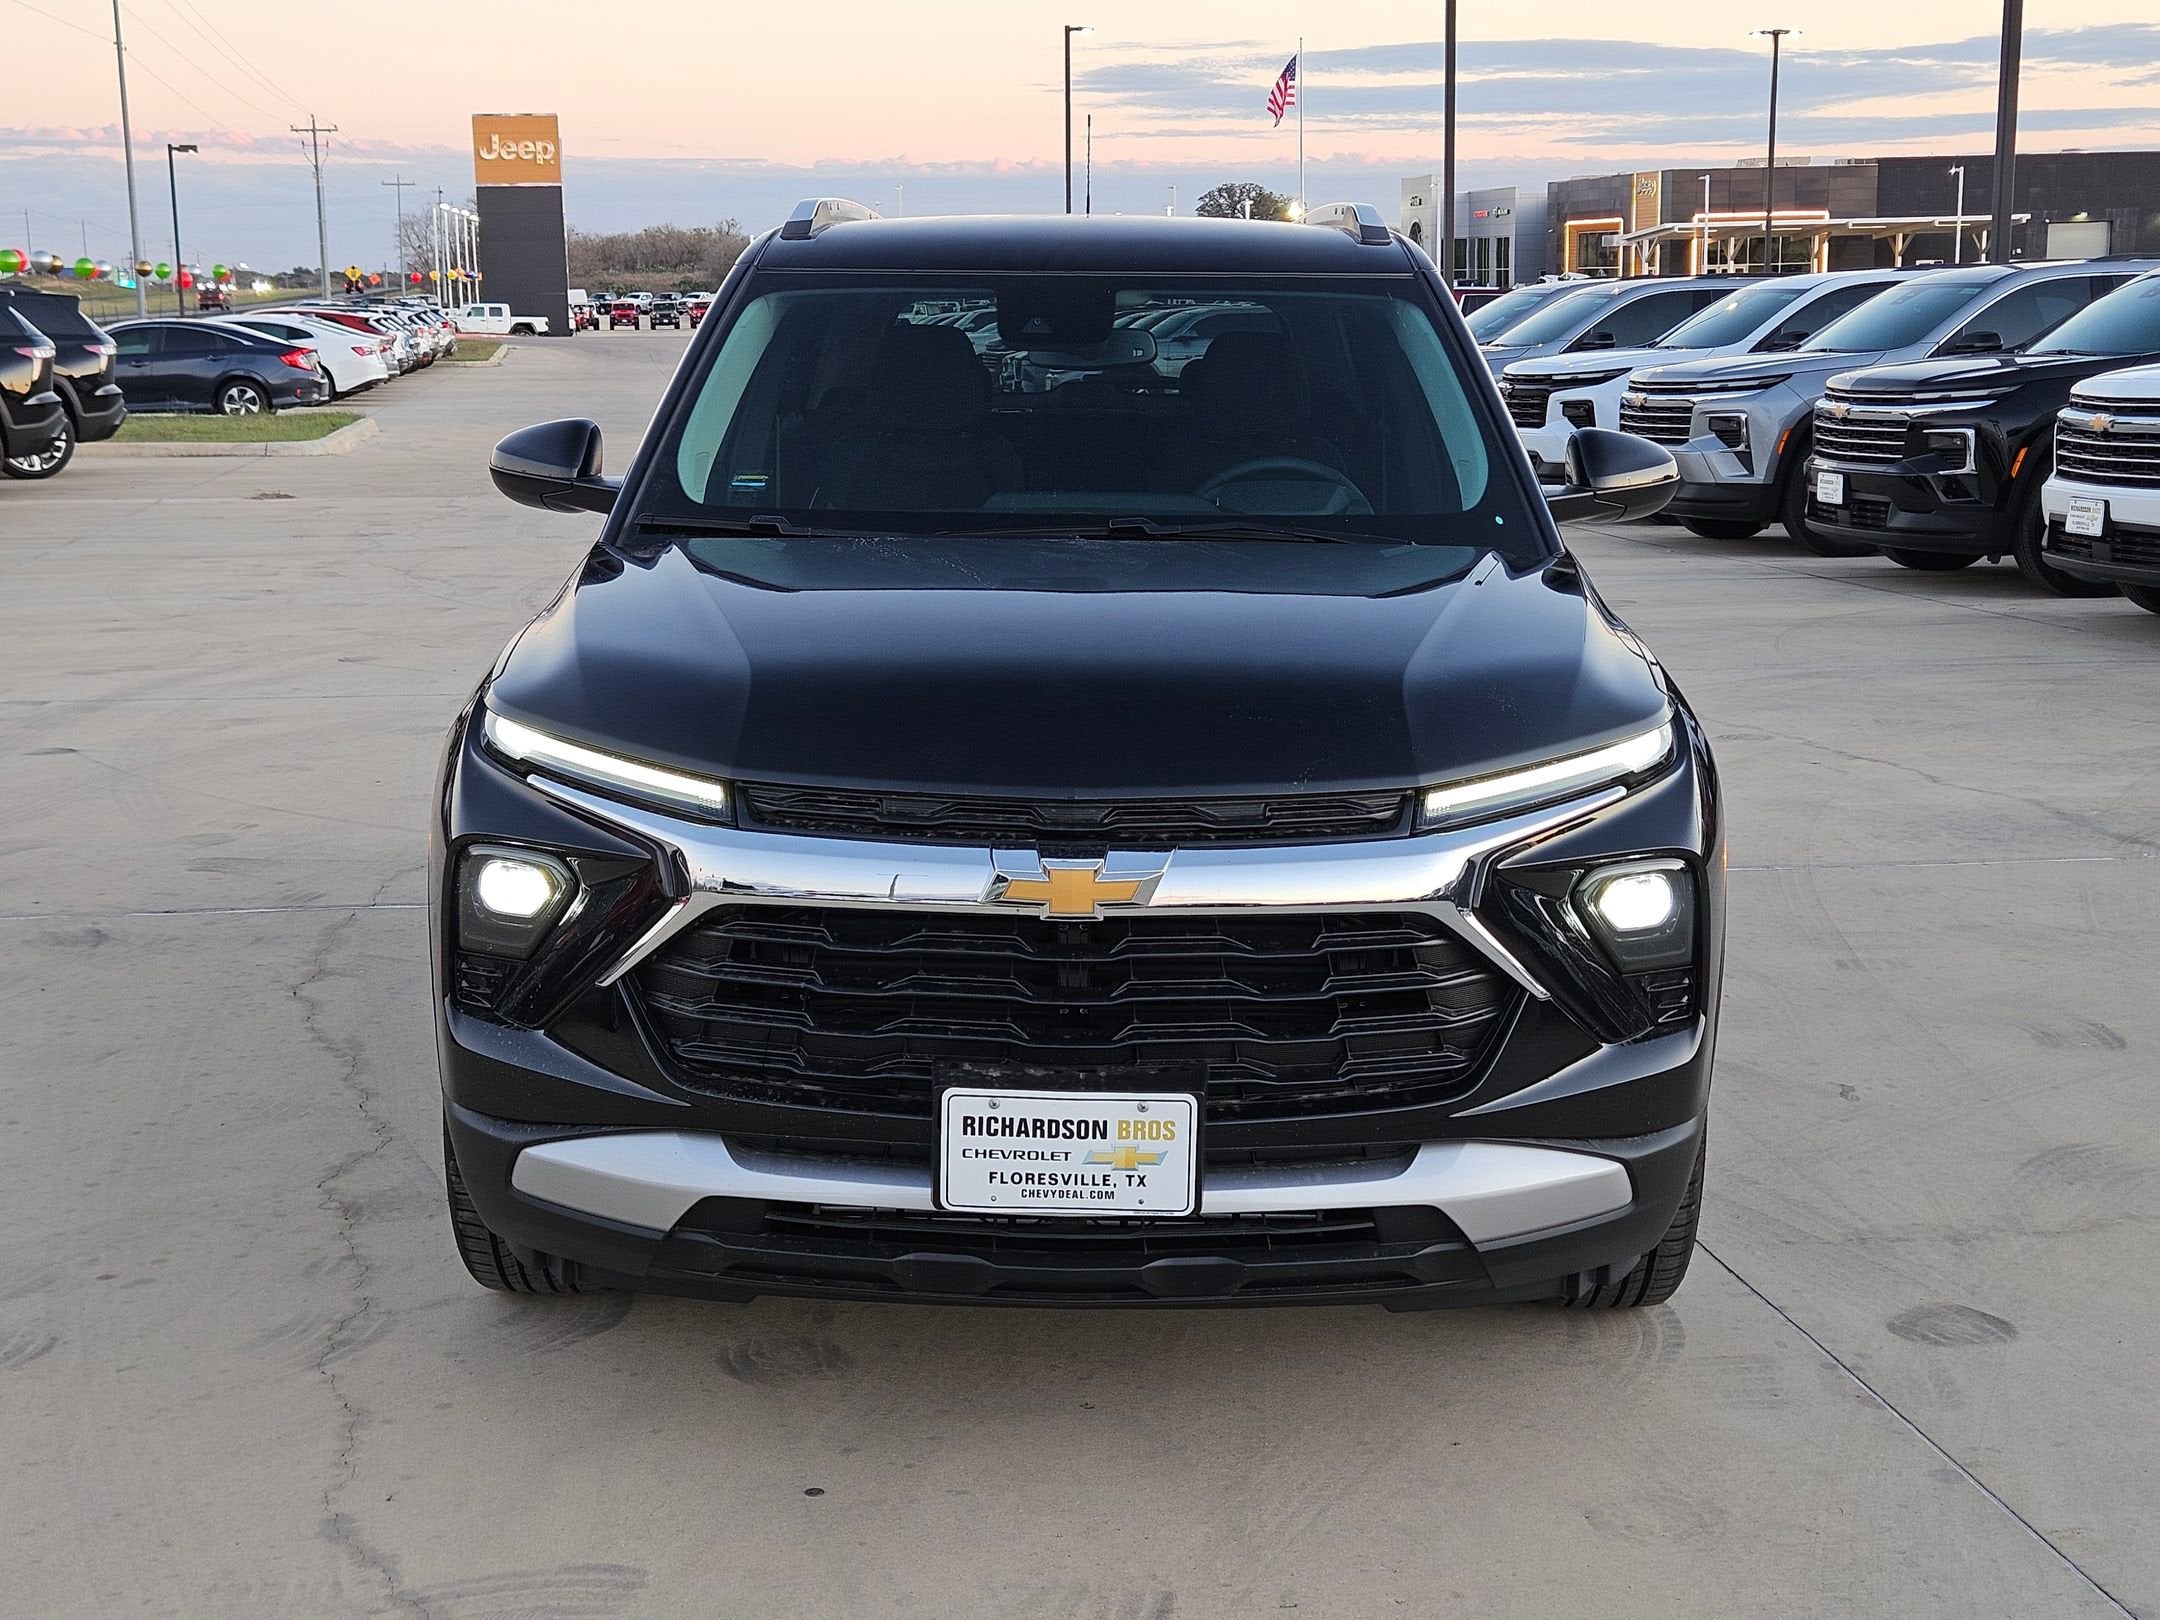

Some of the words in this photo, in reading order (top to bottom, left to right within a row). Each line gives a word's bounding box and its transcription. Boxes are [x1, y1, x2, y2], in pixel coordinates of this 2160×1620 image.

[479, 133, 555, 165] Jeep
[962, 1115, 1108, 1140] RICHARDSON
[1117, 1119, 1176, 1141] BROS
[962, 1148, 1072, 1162] CHEVROLET
[988, 1171, 1117, 1188] FLORESVILLE,
[1125, 1174, 1147, 1187] TX
[1020, 1188, 1115, 1200] CHEVYDEAL.COM
